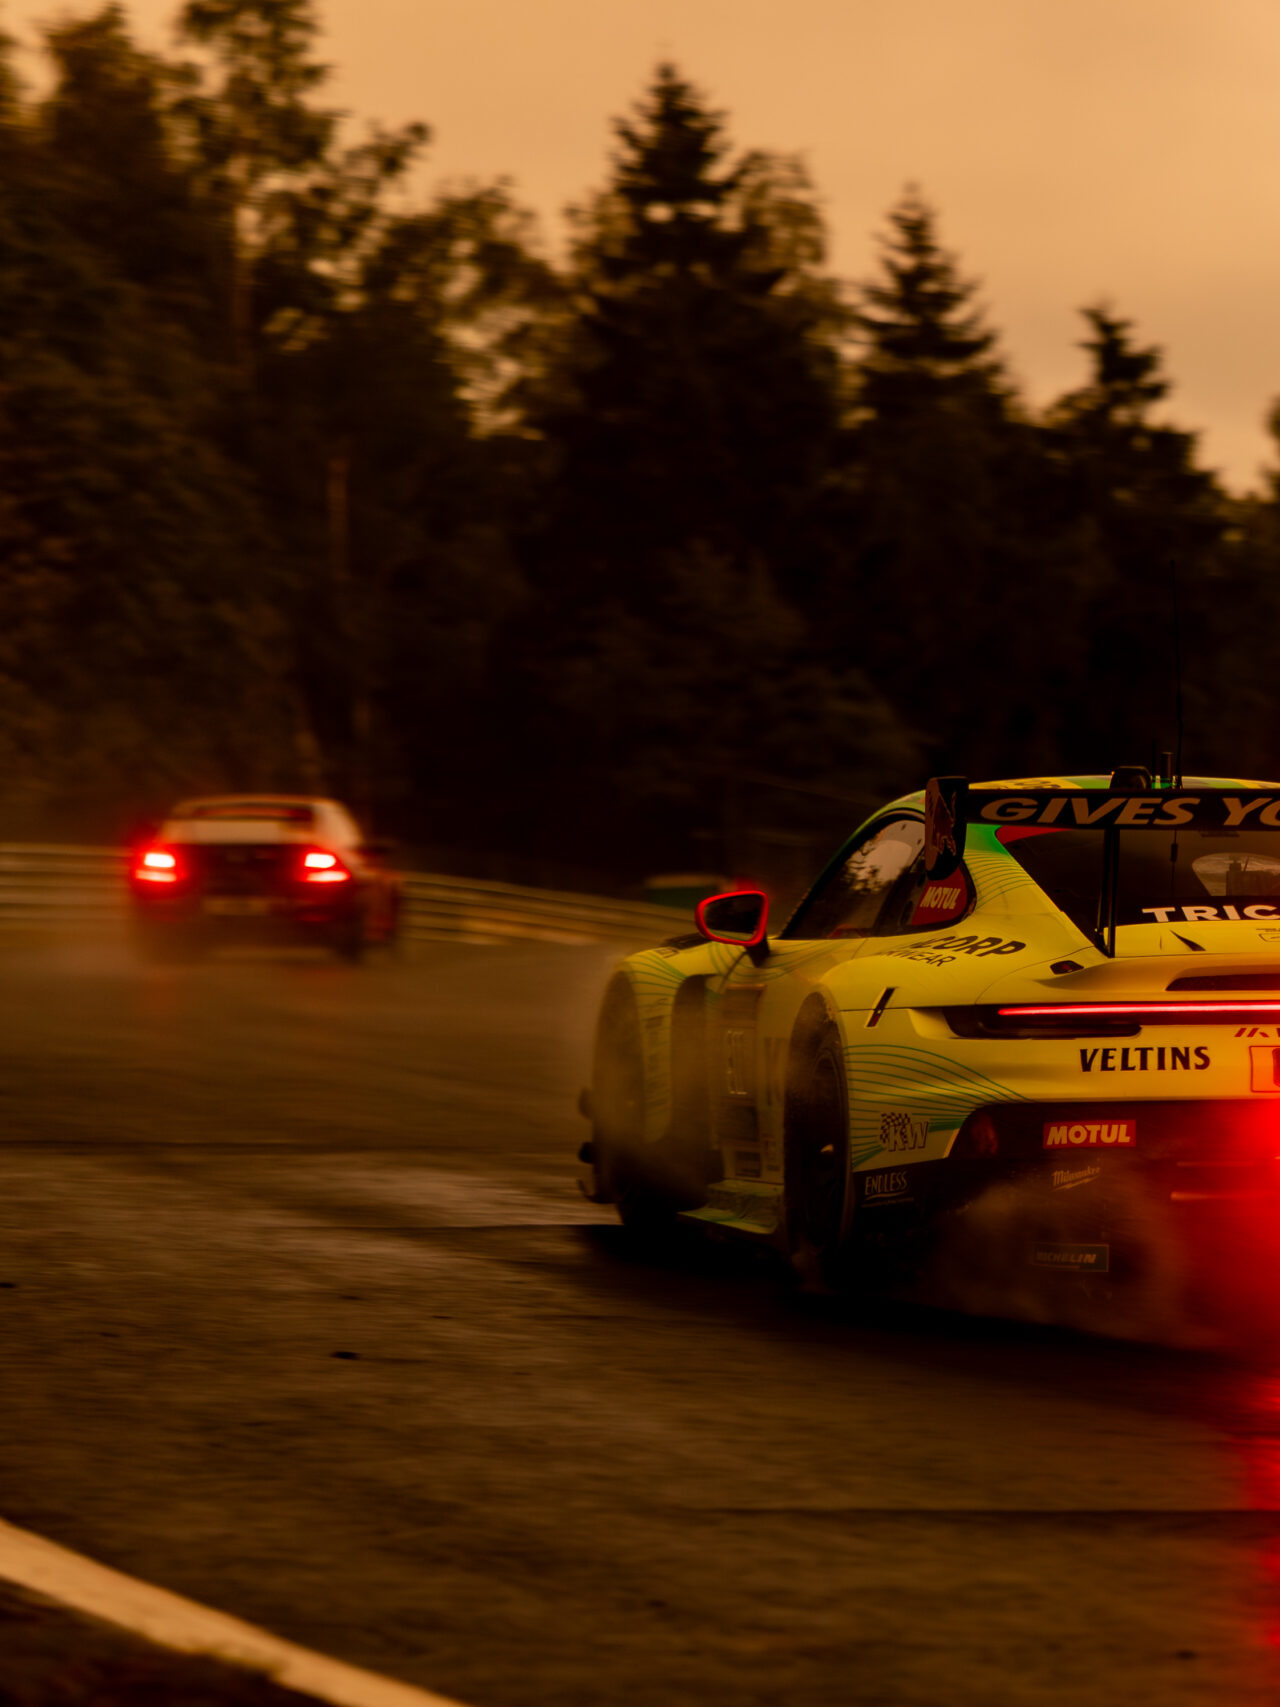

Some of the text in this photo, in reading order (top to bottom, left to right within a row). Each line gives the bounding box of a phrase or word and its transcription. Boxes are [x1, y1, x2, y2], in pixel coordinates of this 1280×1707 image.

[980, 797, 1201, 825] GIVES
[920, 886, 961, 909] MOTUL
[1079, 1046, 1211, 1073] VELTINS
[1047, 1124, 1131, 1146] MOTUL
[864, 1170, 909, 1195] ENDLESS
